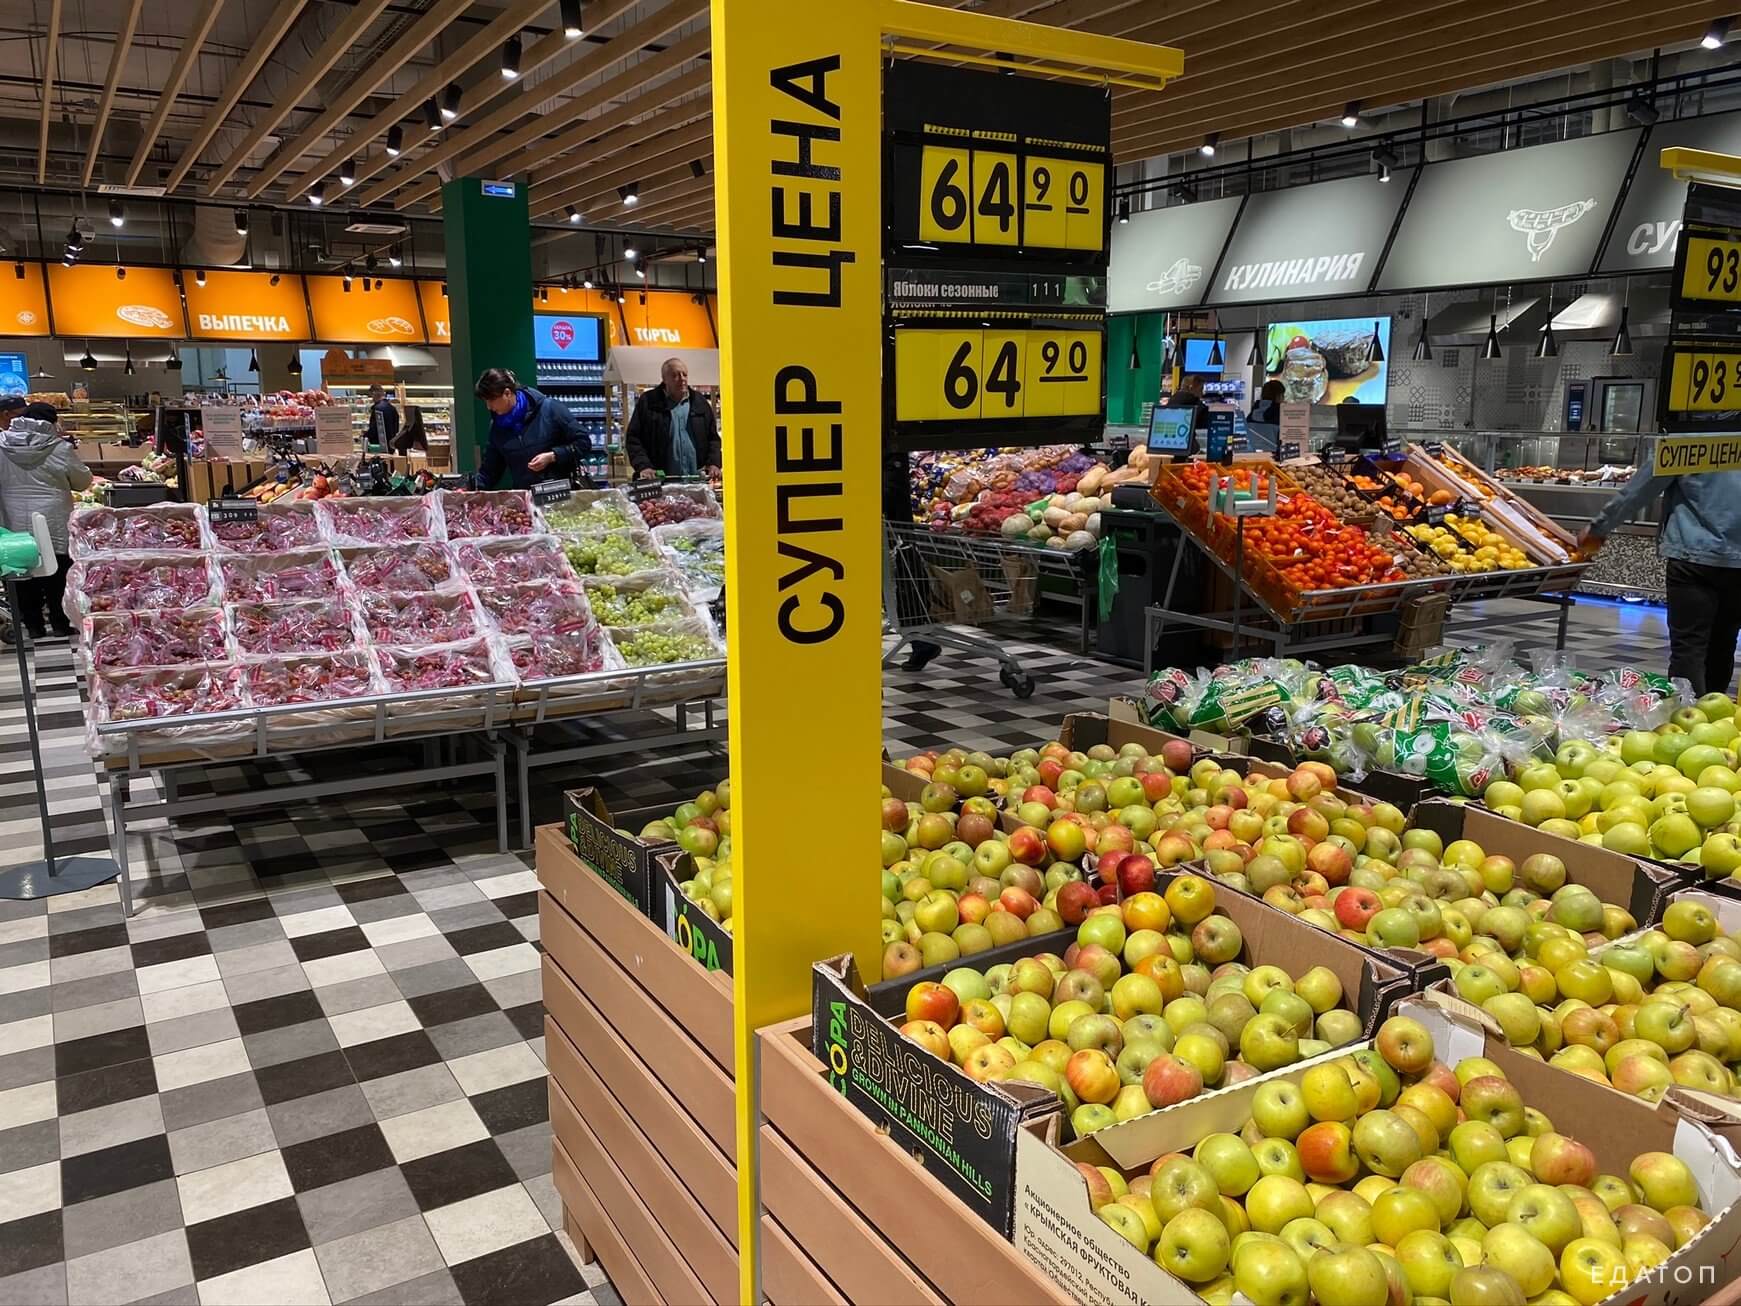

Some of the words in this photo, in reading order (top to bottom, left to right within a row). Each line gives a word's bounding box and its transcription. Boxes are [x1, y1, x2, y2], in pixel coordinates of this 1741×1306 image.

[769, 53, 856, 309] ЦЕНА
[930, 158, 1015, 233] 64
[1032, 166, 1089, 206] 90
[1626, 219, 1682, 256] СУ
[893, 281, 939, 298] Яблоки
[940, 281, 999, 298] сезонные
[1223, 252, 1366, 291] КУЛИНАРИЯ
[1707, 247, 1739, 293] 93
[199, 314, 290, 333] ВЫПЕЧКА
[634, 327, 681, 343] ТОРТЫ
[943, 340, 1021, 410] 64
[1041, 340, 1088, 375] 90
[1692, 360, 1727, 404] 93
[1660, 444, 1708, 468] СУПЕР
[1709, 441, 1741, 469] ЦЕН
[774, 365, 845, 645] СУПЕР
[849, 1006, 993, 1140] DELICIOUS
[851, 1067, 887, 1105] GROWN
[887, 1098, 899, 1114] IN
[899, 1107, 960, 1169] PANNONIAN
[961, 1158, 993, 1197] HILLS
[1024, 1184, 1082, 1240] Акционерное
[1083, 1235, 1131, 1280] общество
[1079, 1247, 1139, 1305] ФРУКТОВАЯ
[1140, 1297, 1151, 1306] К
